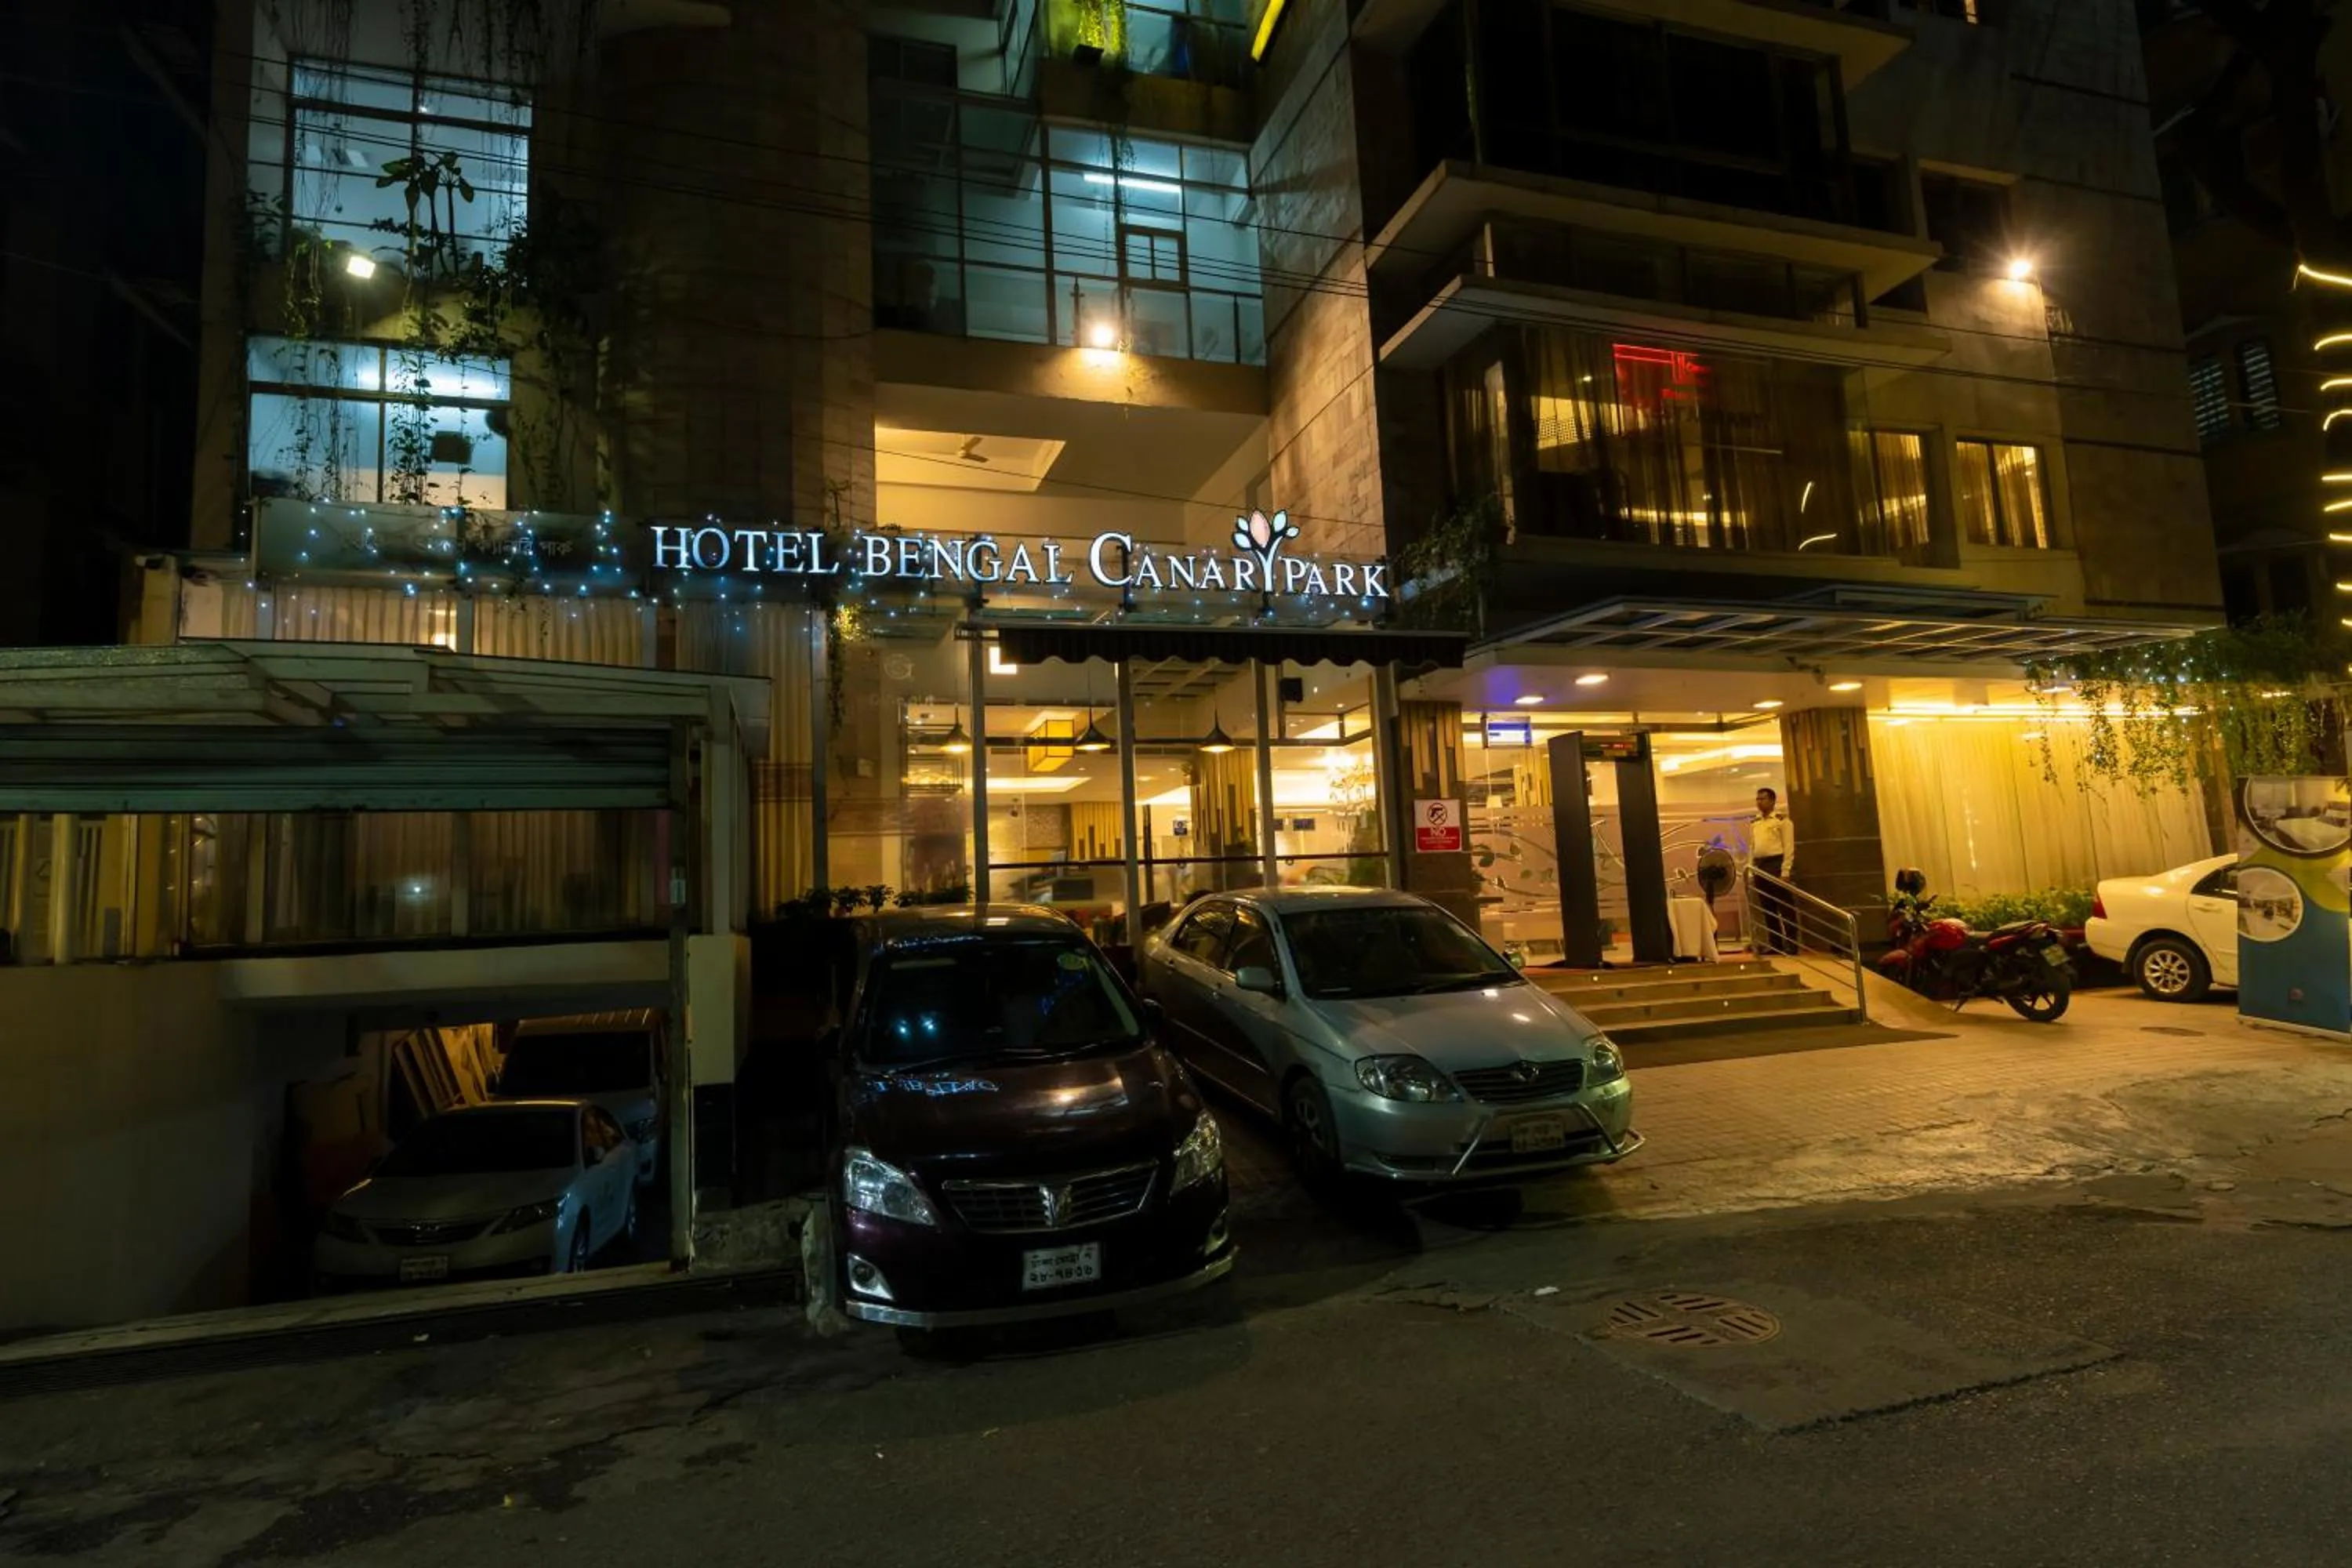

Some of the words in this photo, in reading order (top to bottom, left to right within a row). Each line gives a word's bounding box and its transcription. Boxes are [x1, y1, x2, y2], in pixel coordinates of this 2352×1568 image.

[650, 526, 840, 574] HOTEL
[862, 535, 1075, 584] BENGAL
[1090, 532, 1283, 593] CANARY
[1282, 557, 1388, 597] PARK
